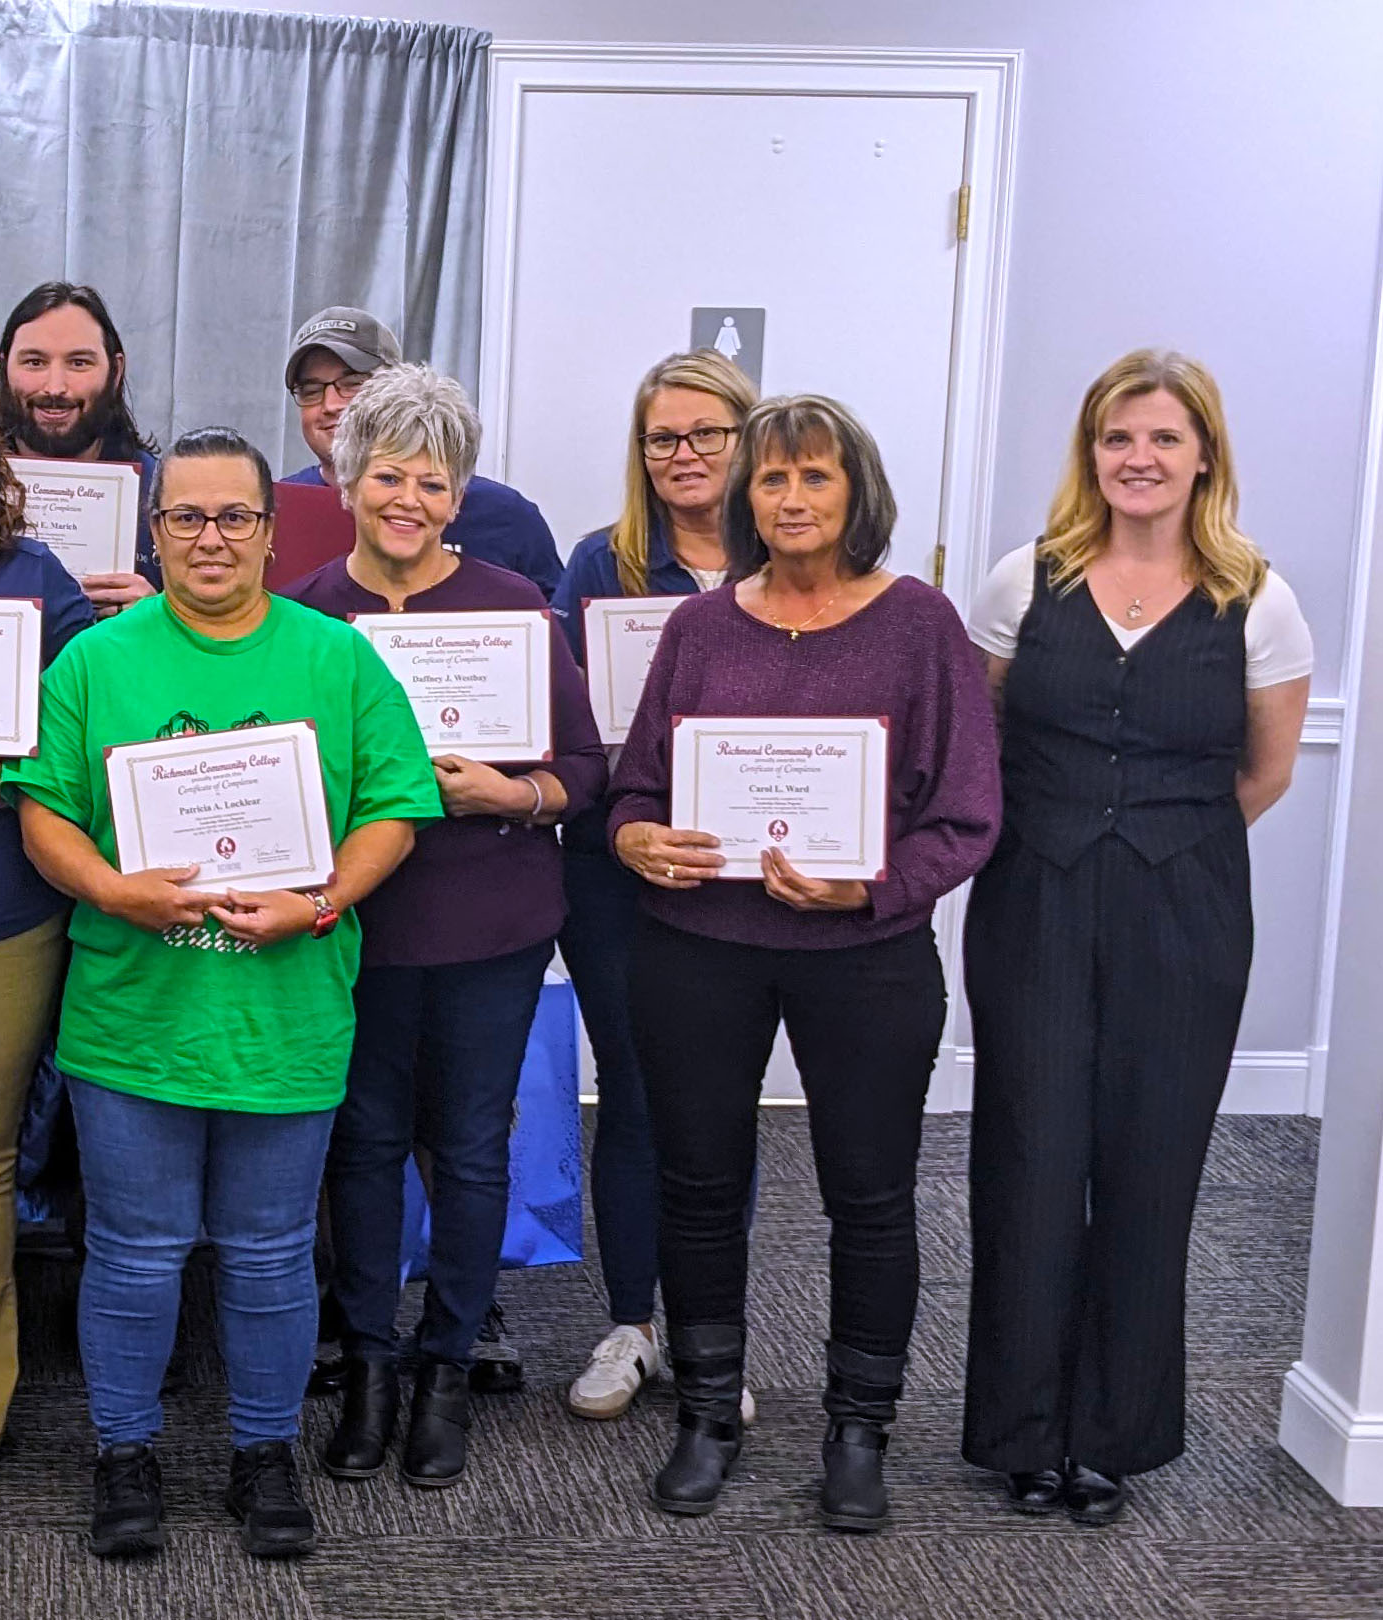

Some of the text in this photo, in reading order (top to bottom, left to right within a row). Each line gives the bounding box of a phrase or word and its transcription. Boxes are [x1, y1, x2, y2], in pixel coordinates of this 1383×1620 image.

[33, 483, 105, 500] Community College
[43, 504, 48, 512] of
[50, 503, 81, 512] Completion
[390, 635, 512, 649] Richmond Community College
[412, 655, 489, 665] Certificate of Completion
[413, 675, 442, 683] Daffney
[716, 741, 847, 758] Richmond Community College
[152, 755, 281, 781] Richmond Community College
[739, 764, 821, 774] Certificate of Completion
[178, 778, 258, 796] Certificate of Completion
[749, 785, 773, 793] Carol
[775, 785, 784, 793] L.
[179, 804, 212, 815] Patricia
[224, 798, 261, 810] Locklear
